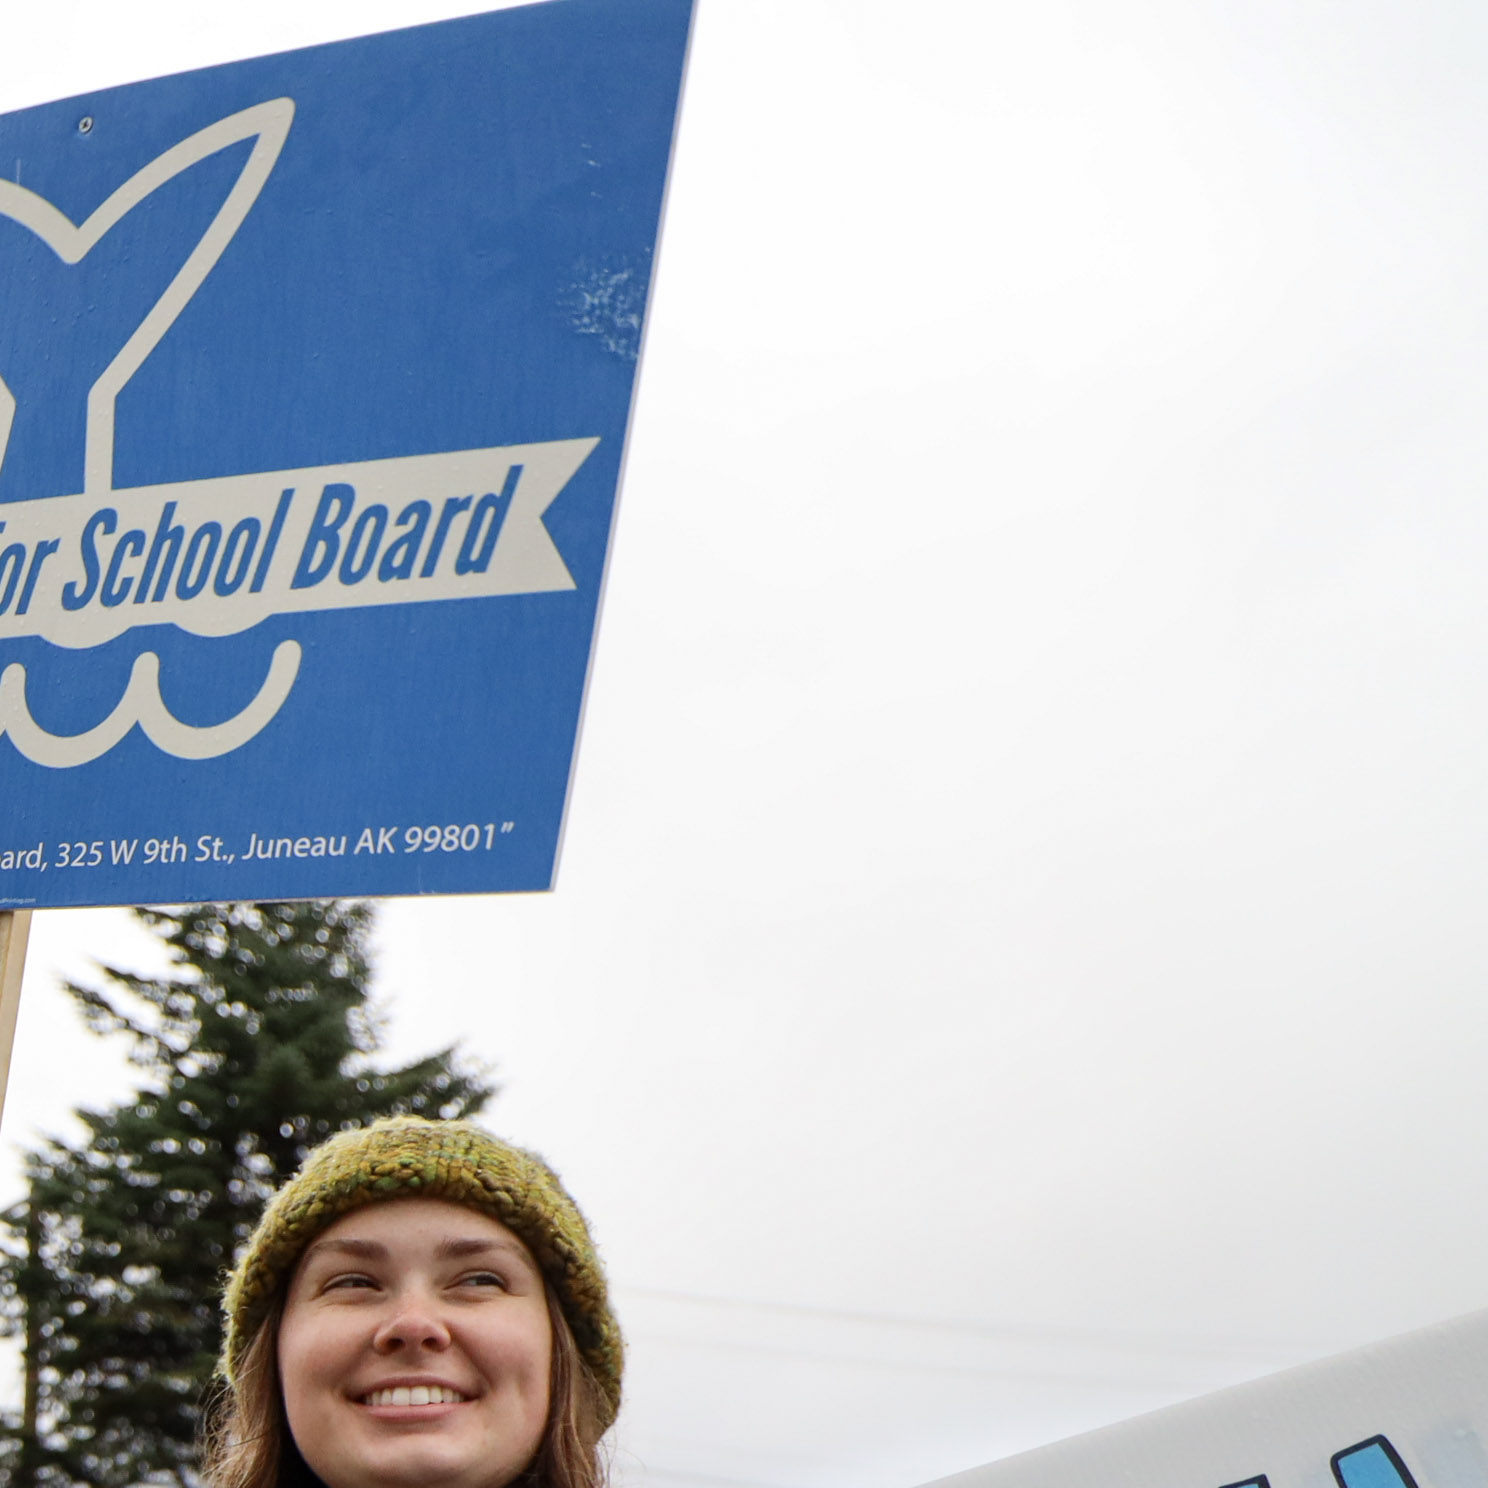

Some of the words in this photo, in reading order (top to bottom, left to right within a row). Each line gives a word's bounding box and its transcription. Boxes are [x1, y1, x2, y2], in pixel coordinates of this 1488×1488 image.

[61, 487, 295, 610] School
[290, 464, 523, 590] Board
[55, 841, 102, 868] 325
[109, 839, 140, 865] W
[143, 835, 187, 864] 9th
[194, 835, 235, 865] St.,
[242, 832, 346, 860] Juneau
[353, 827, 397, 855] AK
